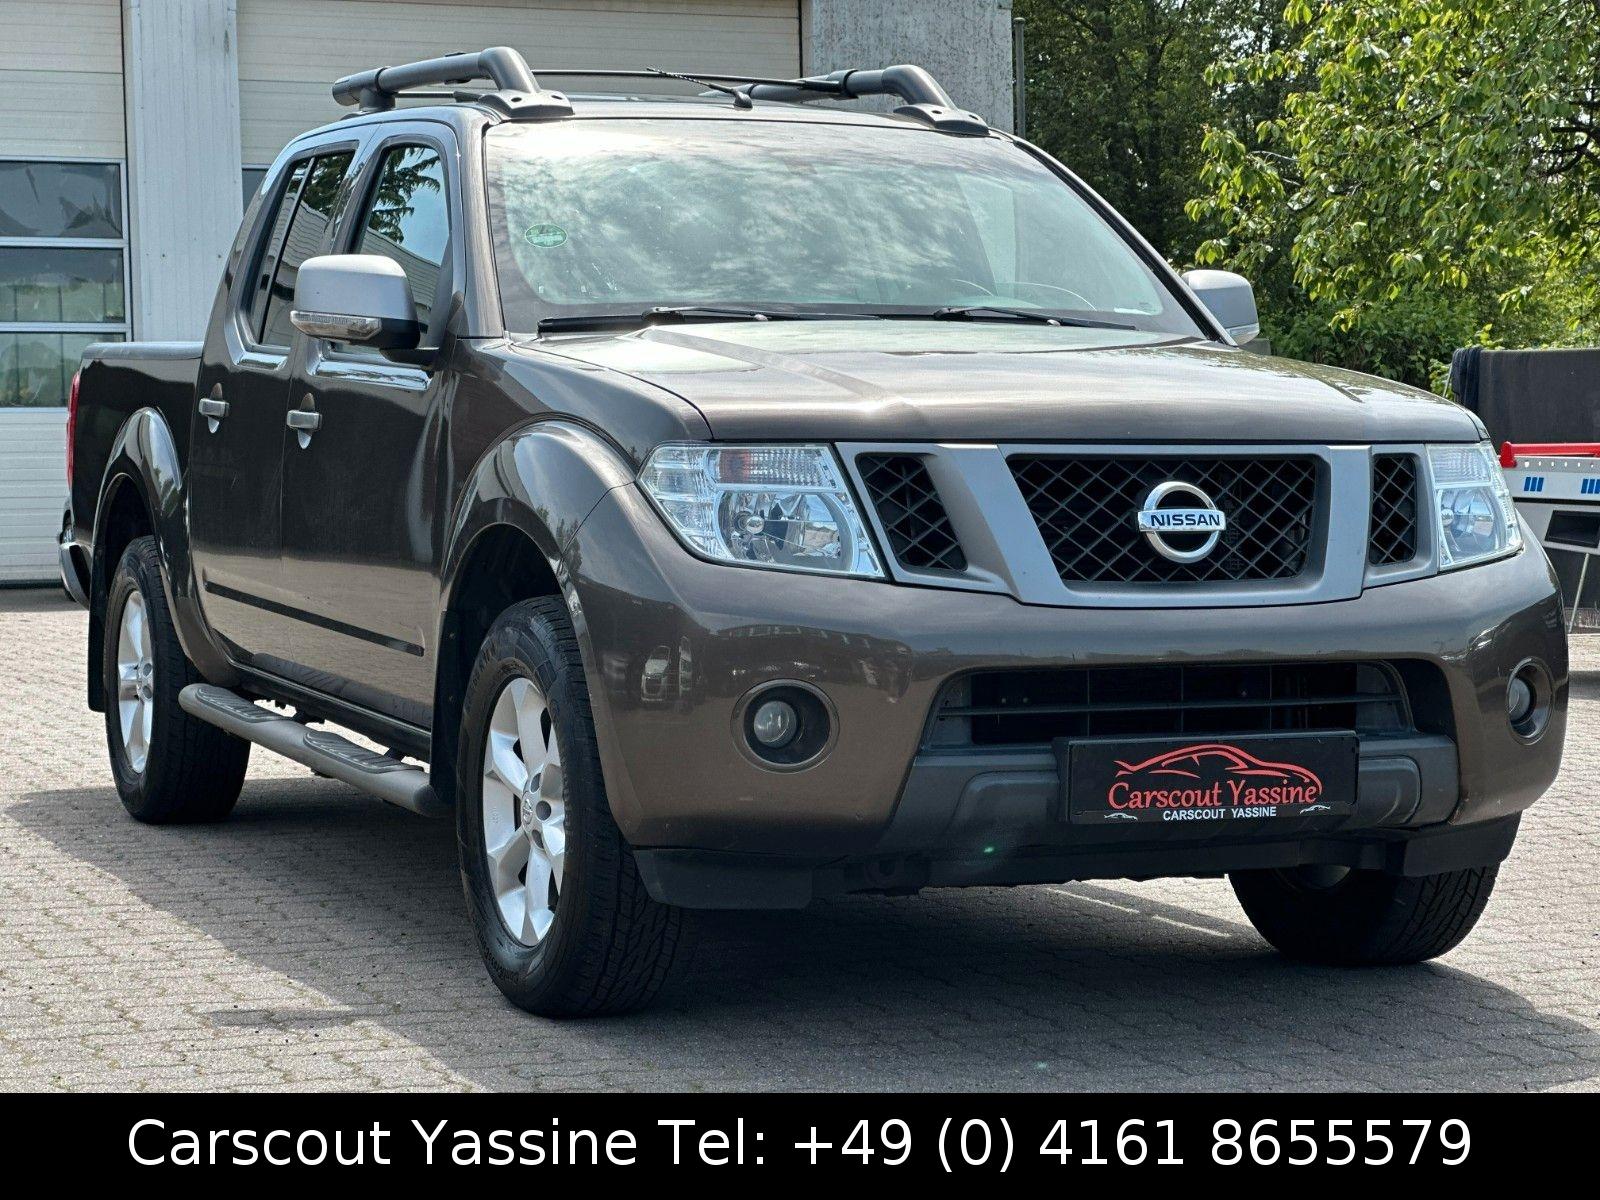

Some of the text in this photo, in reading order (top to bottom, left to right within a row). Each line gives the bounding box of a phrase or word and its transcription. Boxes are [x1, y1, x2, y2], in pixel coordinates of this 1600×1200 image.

[1150, 514, 1220, 526] NISSAN
[1108, 779, 1317, 809] Carscout Yassine
[1163, 806, 1277, 821] CARSCOUT YASSINE
